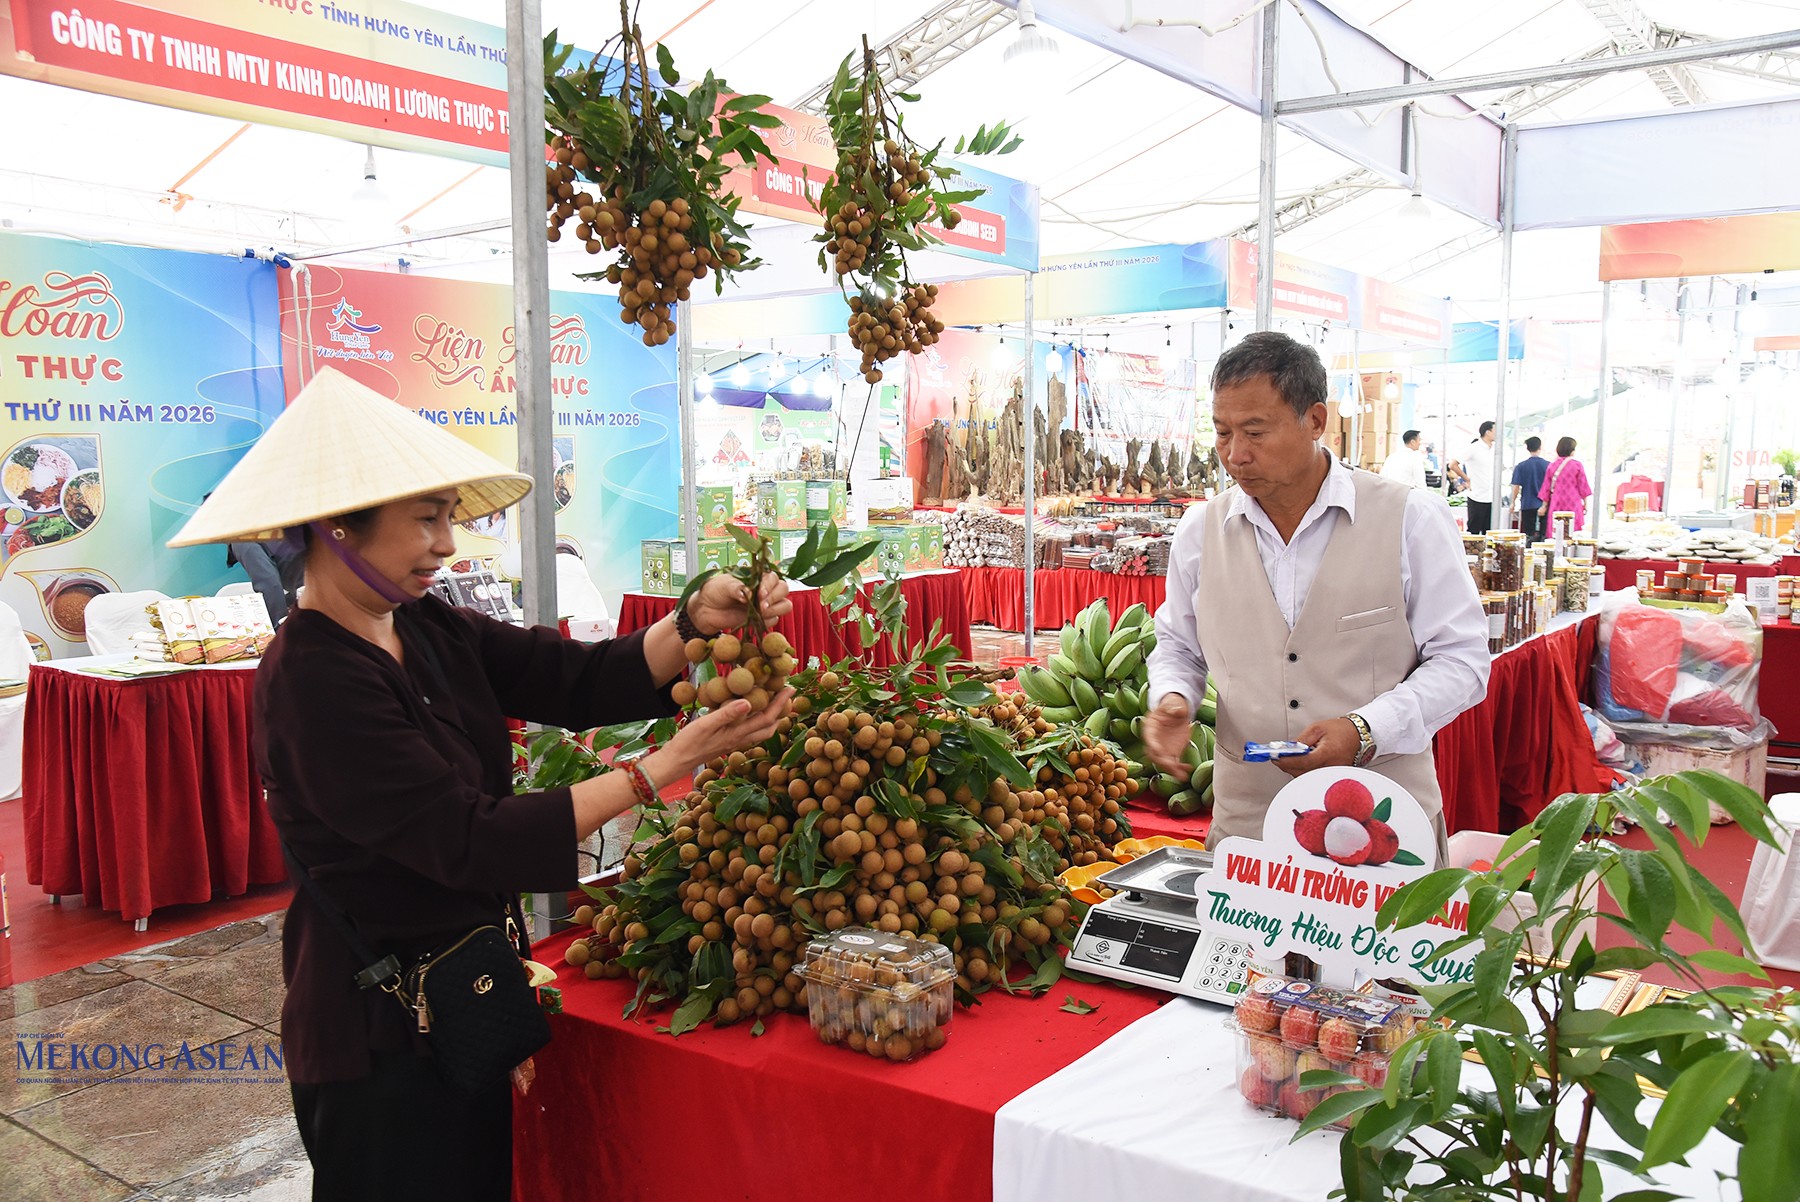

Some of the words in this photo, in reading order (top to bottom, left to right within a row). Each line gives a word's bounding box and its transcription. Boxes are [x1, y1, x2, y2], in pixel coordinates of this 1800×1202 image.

[320, 2, 360, 27] TỈNH
[364, 17, 410, 40] HƯNG
[413, 29, 444, 48] YÊN
[447, 36, 477, 57] LẦN
[51, 8, 123, 57] CÔNG
[126, 28, 155, 63] TY
[161, 36, 222, 77] TNHH
[226, 50, 270, 87] MTV
[275, 61, 324, 98] KINH
[327, 72, 391, 111] DOANH
[394, 87, 451, 123] LƯƠNG
[453, 100, 495, 135] THỰC
[765, 167, 793, 195] CÔNG
[980, 223, 997, 242] SEED
[1047, 264, 1067, 272] HƯNG
[1069, 262, 1083, 270] YÊN
[1142, 256, 1160, 264] 2026
[16, 354, 123, 386] THỰC
[5, 398, 62, 422] THỨ
[69, 403, 91, 422] III
[100, 400, 154, 422] NĂM
[160, 405, 215, 423] 2026
[453, 407, 485, 425] YÊN
[490, 406, 518, 425] LẦN
[558, 412, 571, 426] III
[575, 409, 605, 426] NĂM
[609, 413, 640, 427] 2026
[1226, 853, 1262, 886] VUA
[1267, 854, 1299, 894] VẢI
[1302, 867, 1369, 909] TRỨNG
[1207, 889, 1283, 948] Thương
[1291, 910, 1343, 953] Hiệu
[1351, 924, 1401, 967] Độc
[1213, 955, 1220, 963] 4
[1226, 957, 1234, 966] 5
[1231, 946, 1239, 954] 8
[1202, 978, 1210, 986] 0
[1221, 969, 1229, 977] 2
[1235, 972, 1243, 980] 3
